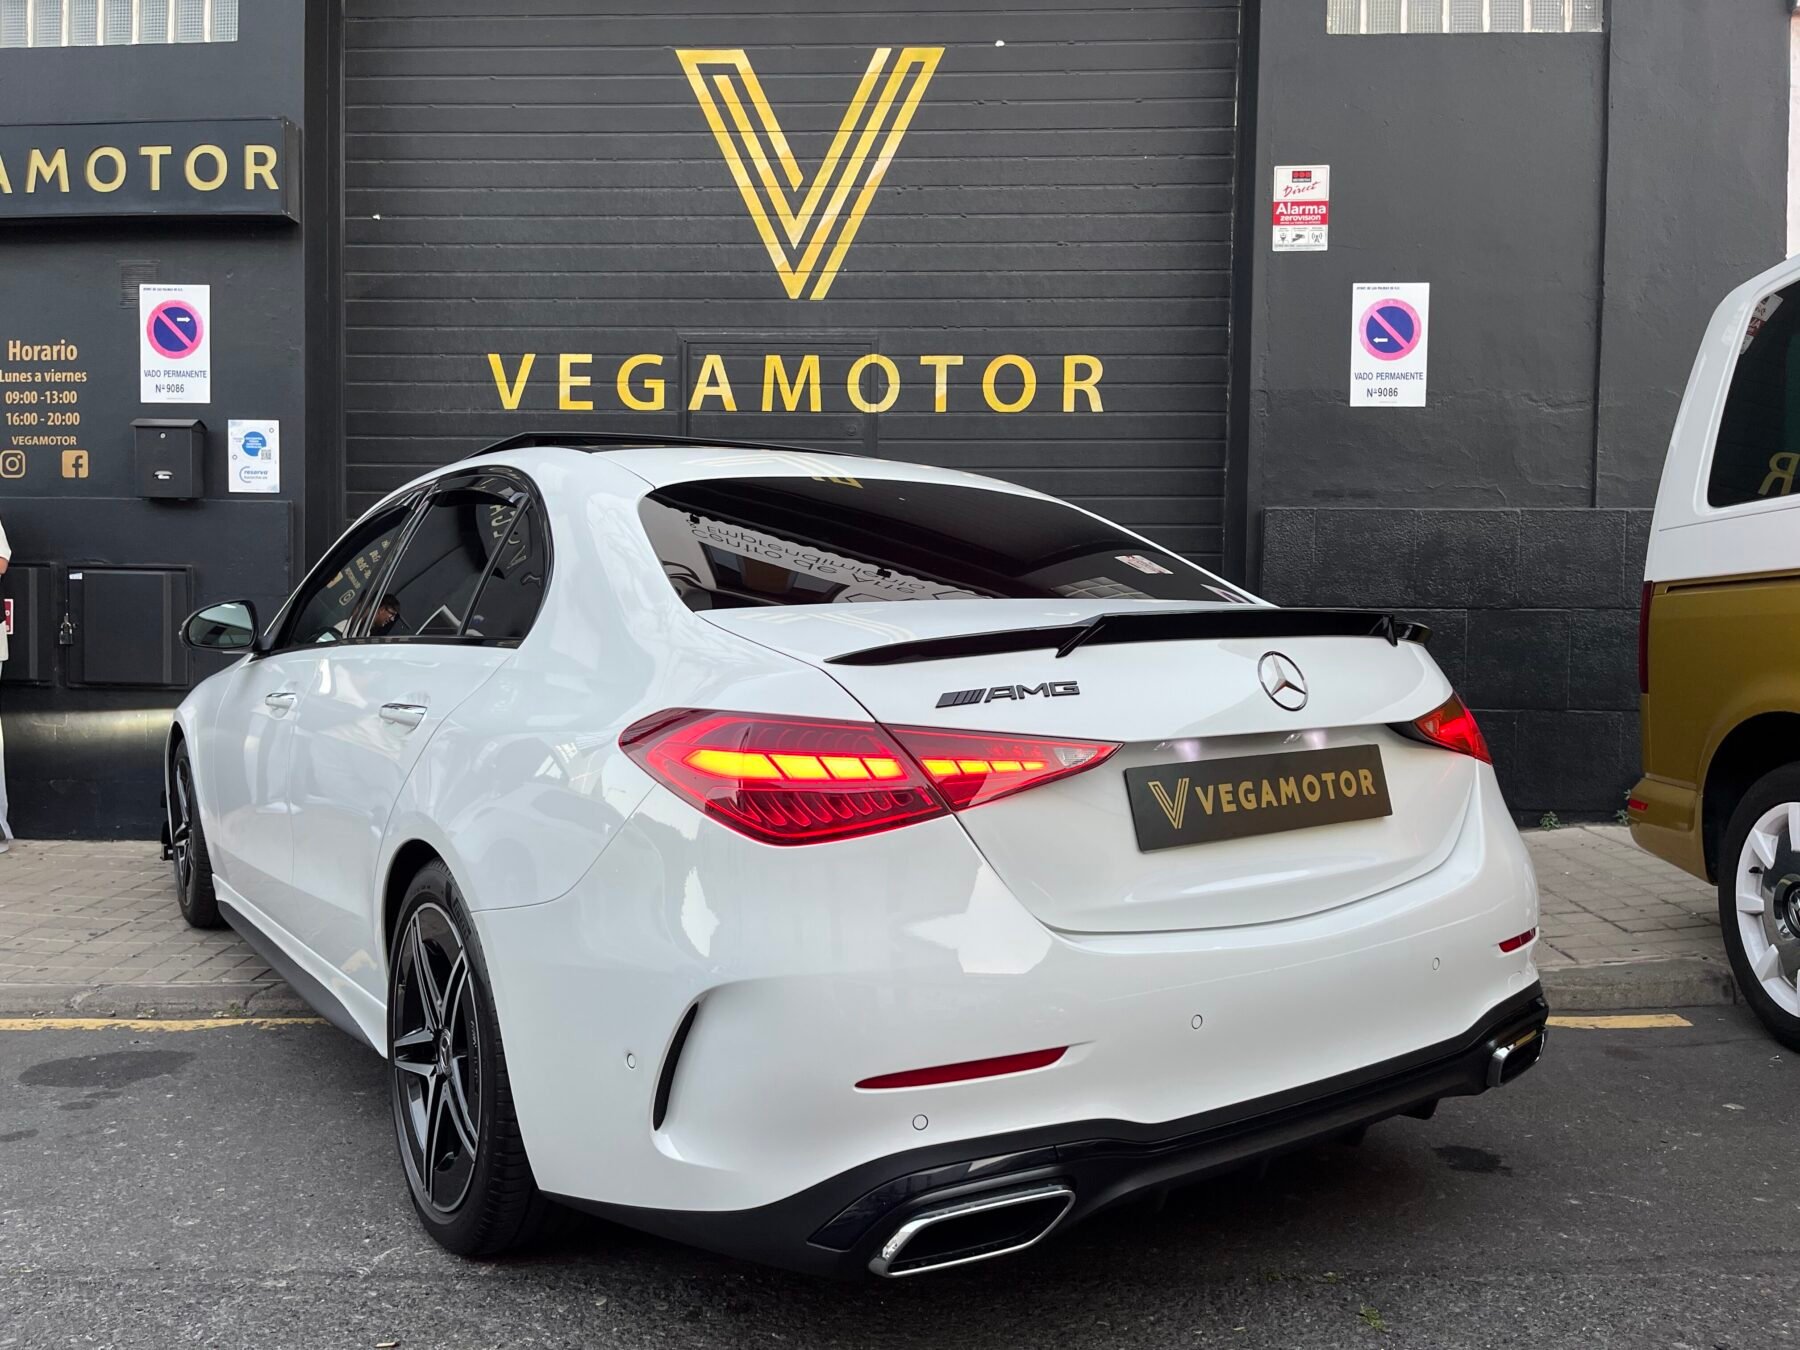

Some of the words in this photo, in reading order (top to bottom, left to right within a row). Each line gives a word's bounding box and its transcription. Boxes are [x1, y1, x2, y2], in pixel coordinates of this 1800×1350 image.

[1276, 202, 1327, 215] Alarma
[8, 339, 78, 361] Horario
[0, 370, 32, 382] Lunes
[34, 373, 41, 382] a
[44, 369, 87, 382] viernes
[144, 370, 161, 378] VADO
[163, 370, 207, 378] PERMANENTE
[1354, 372, 1374, 381] VADO
[1375, 372, 1424, 381] PERMANENTE
[487, 352, 1105, 413] VEGAMOTOR
[5, 391, 38, 404] 09:00
[6, 413, 38, 425] 16:00
[47, 412, 80, 425] 20:00
[11, 436, 77, 446] VEGAMOTOR
[1195, 768, 1377, 817] VEGAMOTOR
